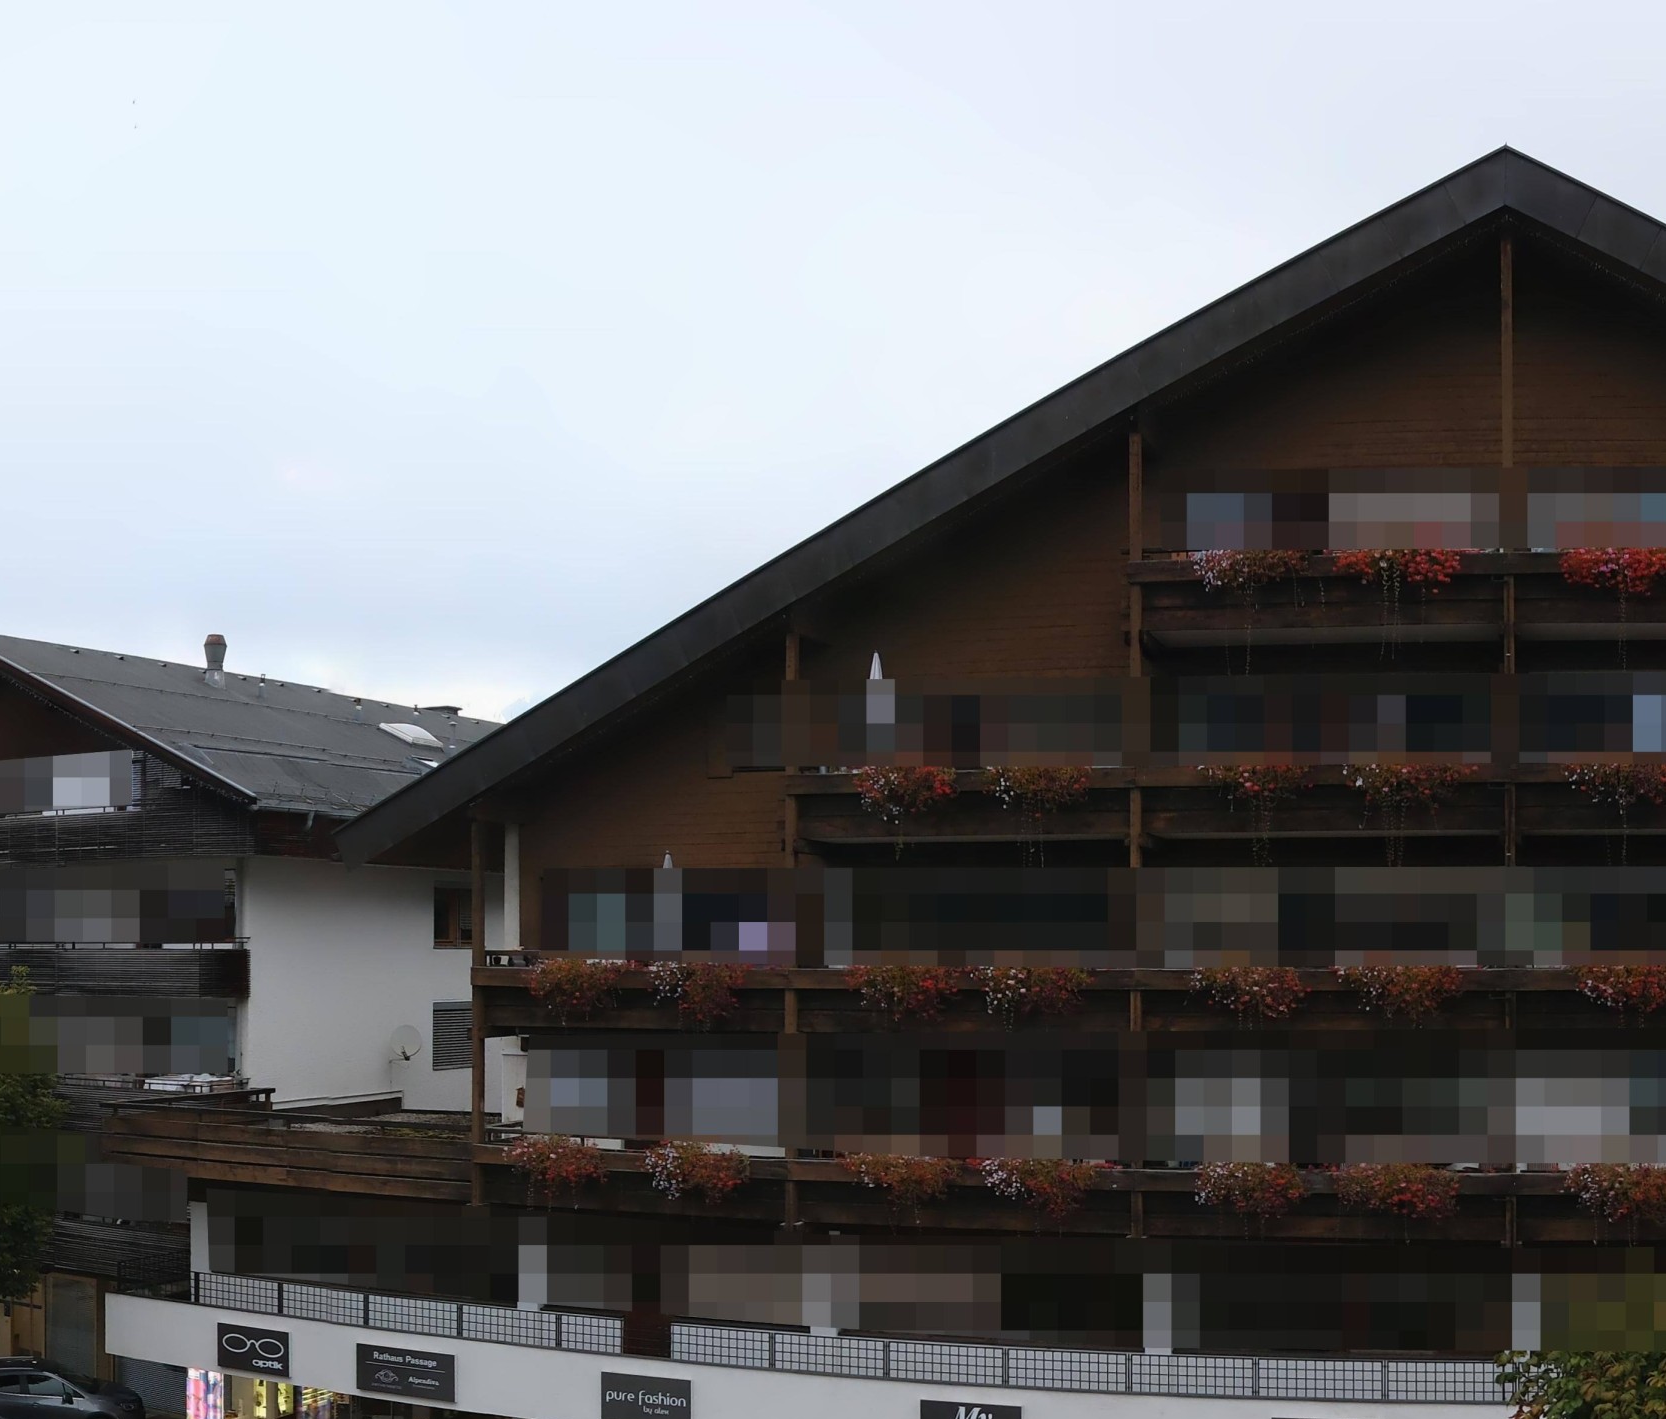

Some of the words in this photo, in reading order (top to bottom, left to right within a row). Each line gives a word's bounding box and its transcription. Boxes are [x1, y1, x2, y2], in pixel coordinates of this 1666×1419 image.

[252, 1358, 283, 1370] optik
[373, 1351, 403, 1363] Rathaus
[405, 1355, 437, 1368] Passage
[606, 1390, 635, 1402] pure
[639, 1390, 686, 1407] fashion
[643, 1406, 653, 1415] by
[654, 1407, 669, 1415] alex
